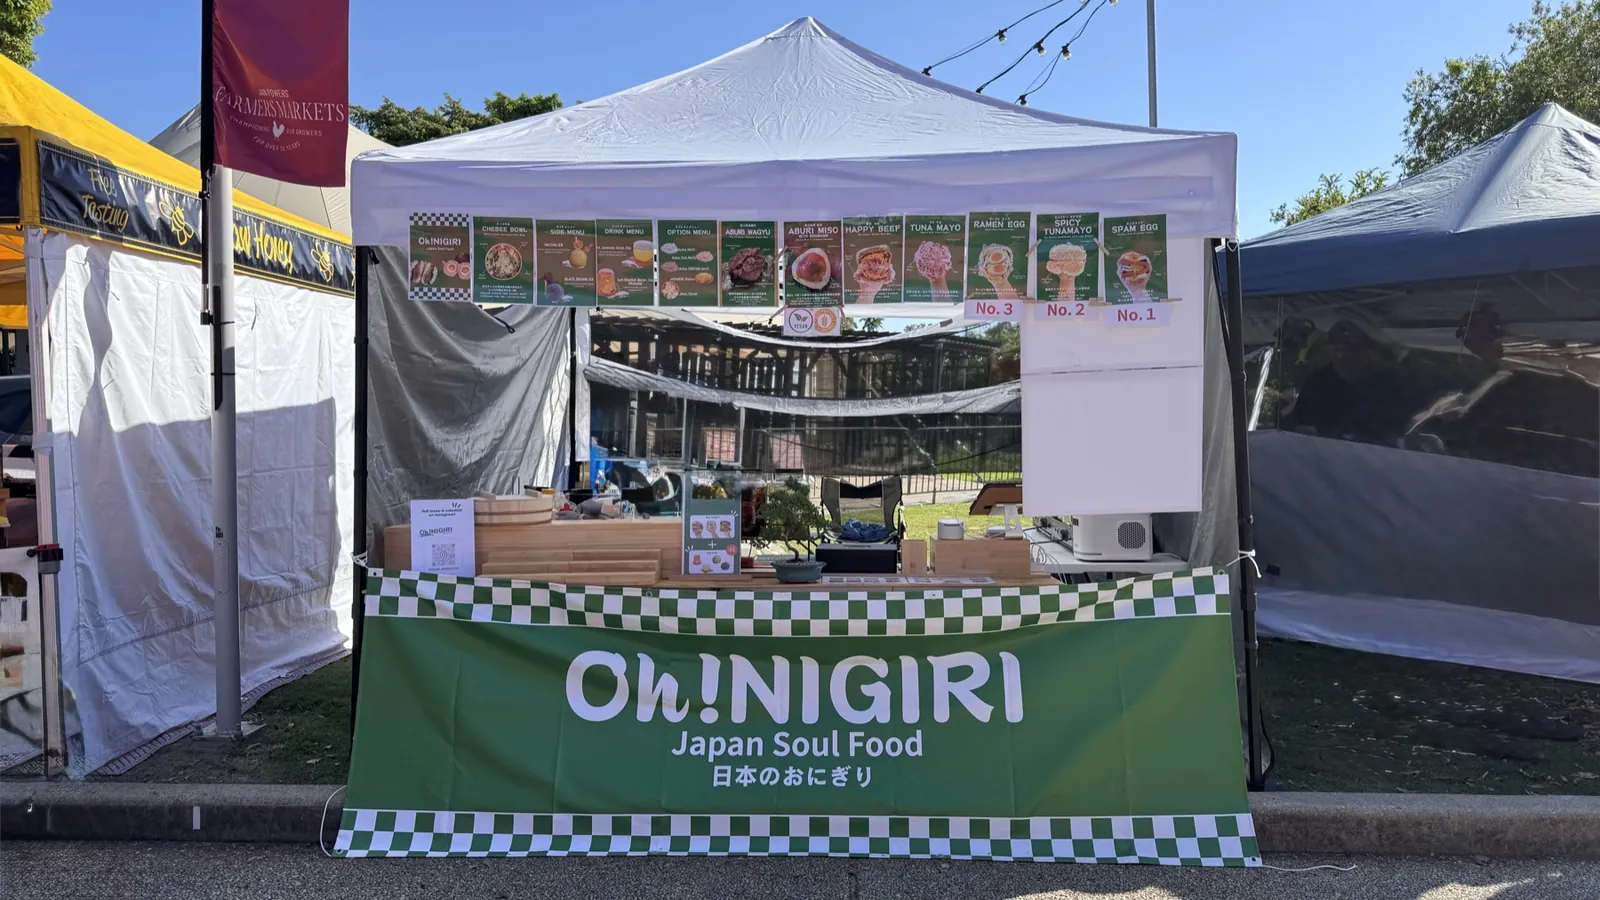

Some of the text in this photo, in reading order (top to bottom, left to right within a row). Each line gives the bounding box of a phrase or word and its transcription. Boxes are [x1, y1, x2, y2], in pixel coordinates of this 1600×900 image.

[214, 86, 345, 122] FARMERS MARKETS
[252, 136, 264, 146] FOR
[87, 168, 118, 197] Free
[82, 194, 129, 233] Tasting
[1054, 219, 1081, 227] SPICY
[1043, 226, 1092, 235] TUNAMAYO
[1112, 224, 1158, 234] SPAM EGG
[232, 222, 293, 274] aw Honey
[564, 650, 1024, 724] Oh!NIGIRI
[671, 729, 924, 762] Japan Soul Food
[712, 765, 873, 788] 日本のおにぎり
